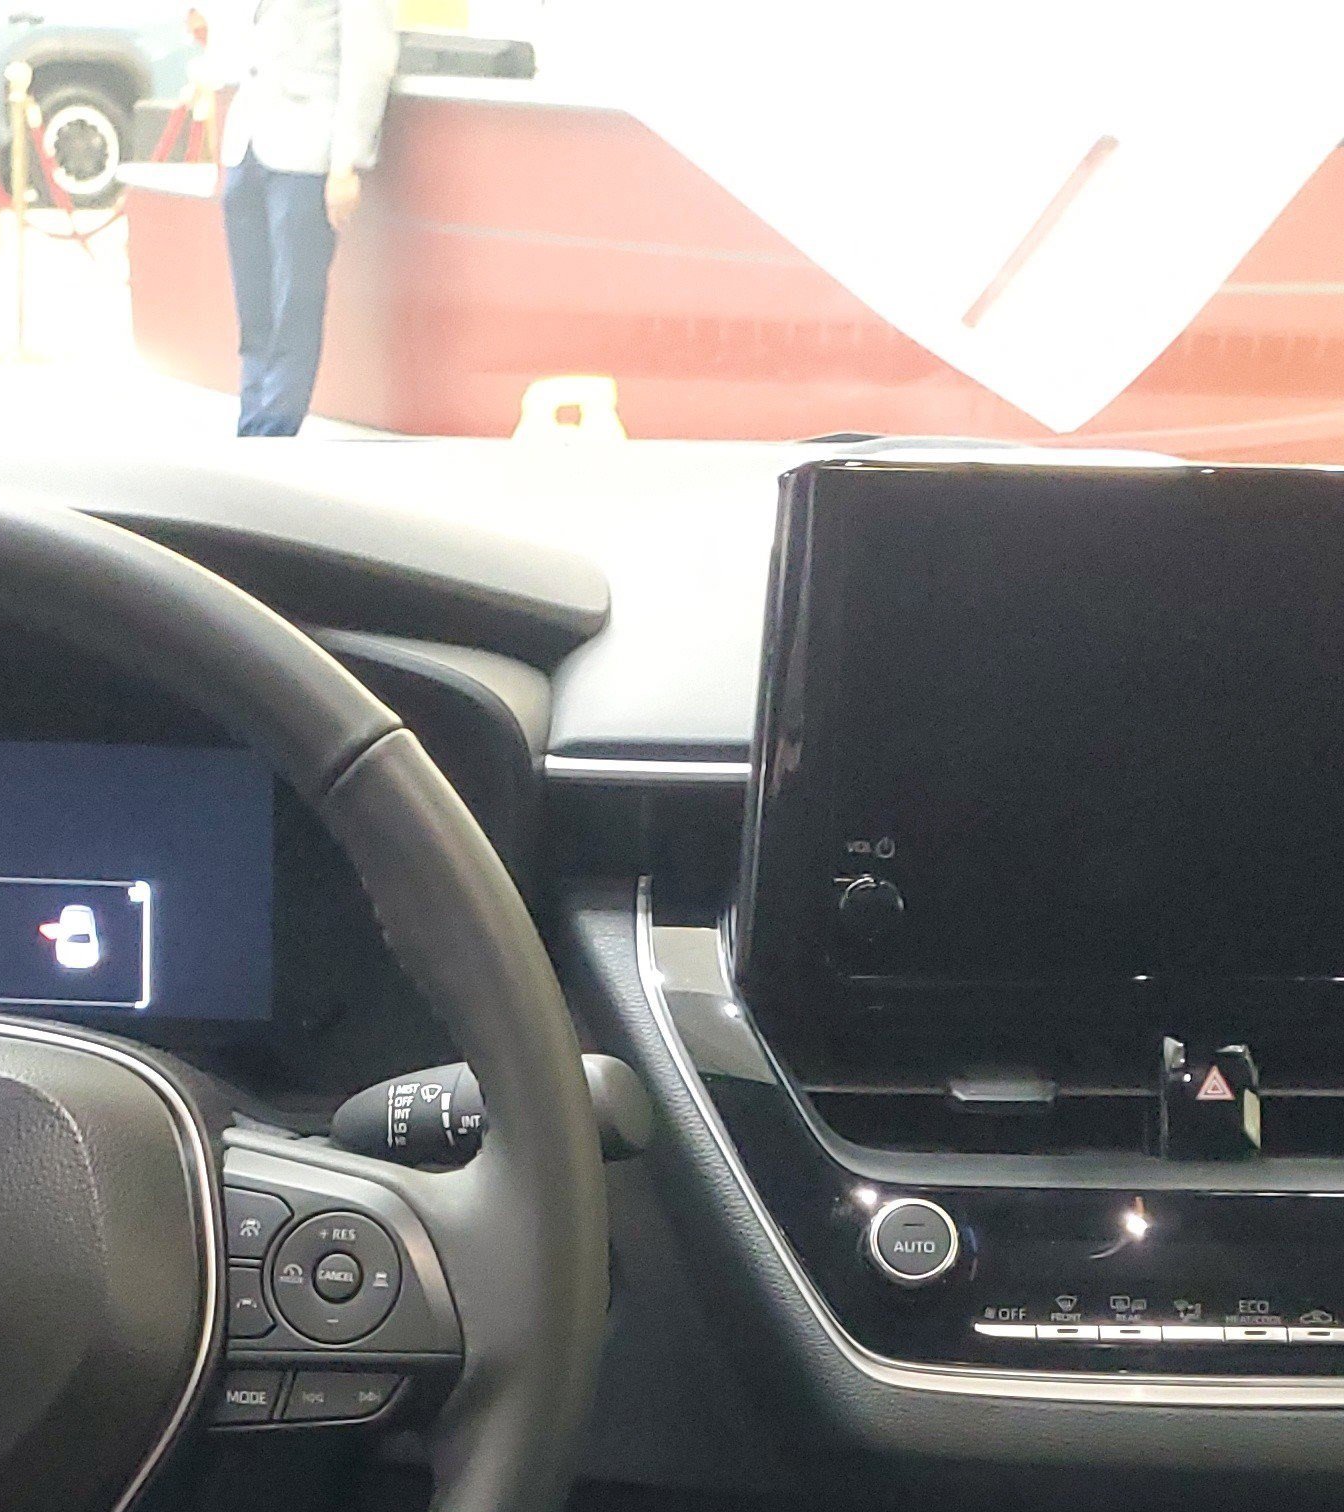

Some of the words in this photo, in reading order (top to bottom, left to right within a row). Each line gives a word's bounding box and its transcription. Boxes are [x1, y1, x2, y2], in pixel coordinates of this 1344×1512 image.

[394, 1095, 414, 1107] OFF
[394, 1108, 411, 1120] INT
[461, 1114, 481, 1128] INT
[332, 1228, 356, 1241] RES
[893, 1240, 936, 1254] AUTO
[318, 1269, 354, 1283] CANCEL
[1238, 1299, 1270, 1314] ECO
[998, 1307, 1027, 1321] OFF
[226, 1389, 267, 1405] MODE
